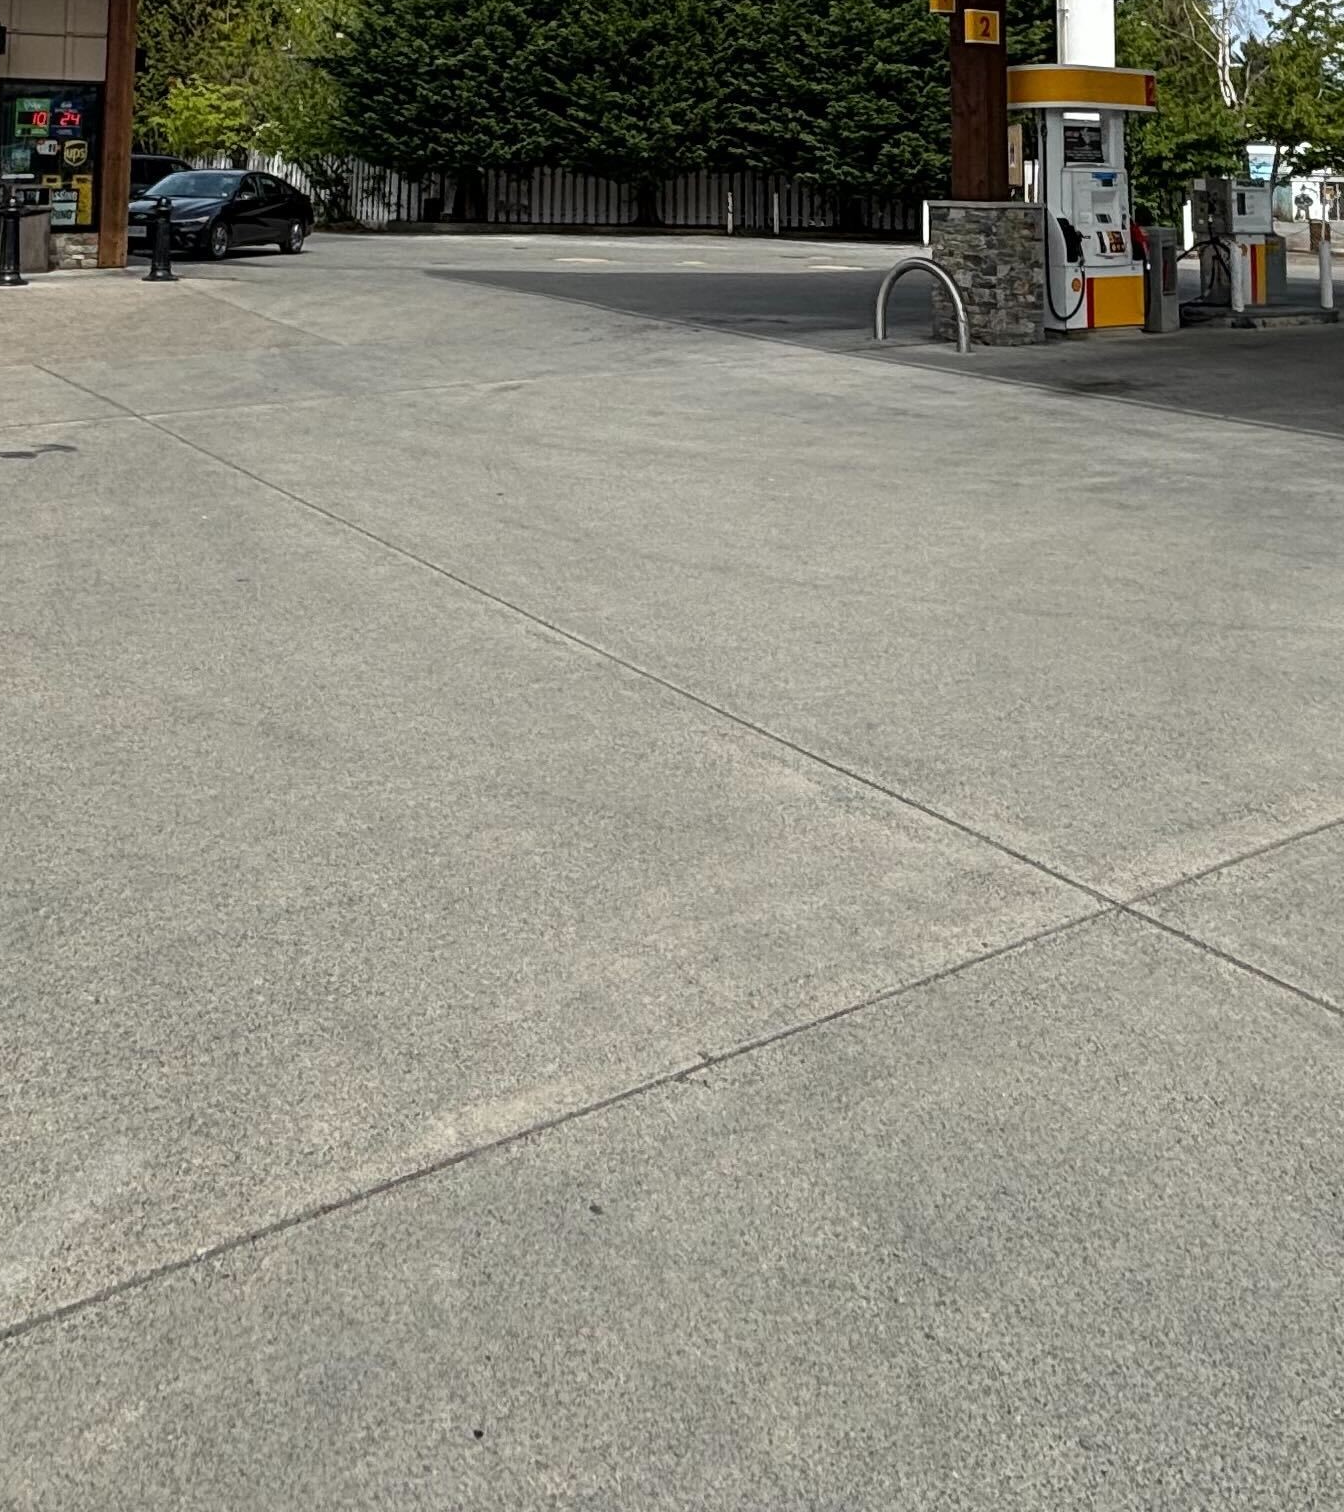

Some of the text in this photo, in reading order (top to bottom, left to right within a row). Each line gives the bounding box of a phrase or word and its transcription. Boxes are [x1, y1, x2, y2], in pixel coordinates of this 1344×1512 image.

[979, 16, 991, 38] 2
[32, 111, 48, 127] 10
[60, 112, 80, 126] 24
[65, 149, 86, 163] ups
